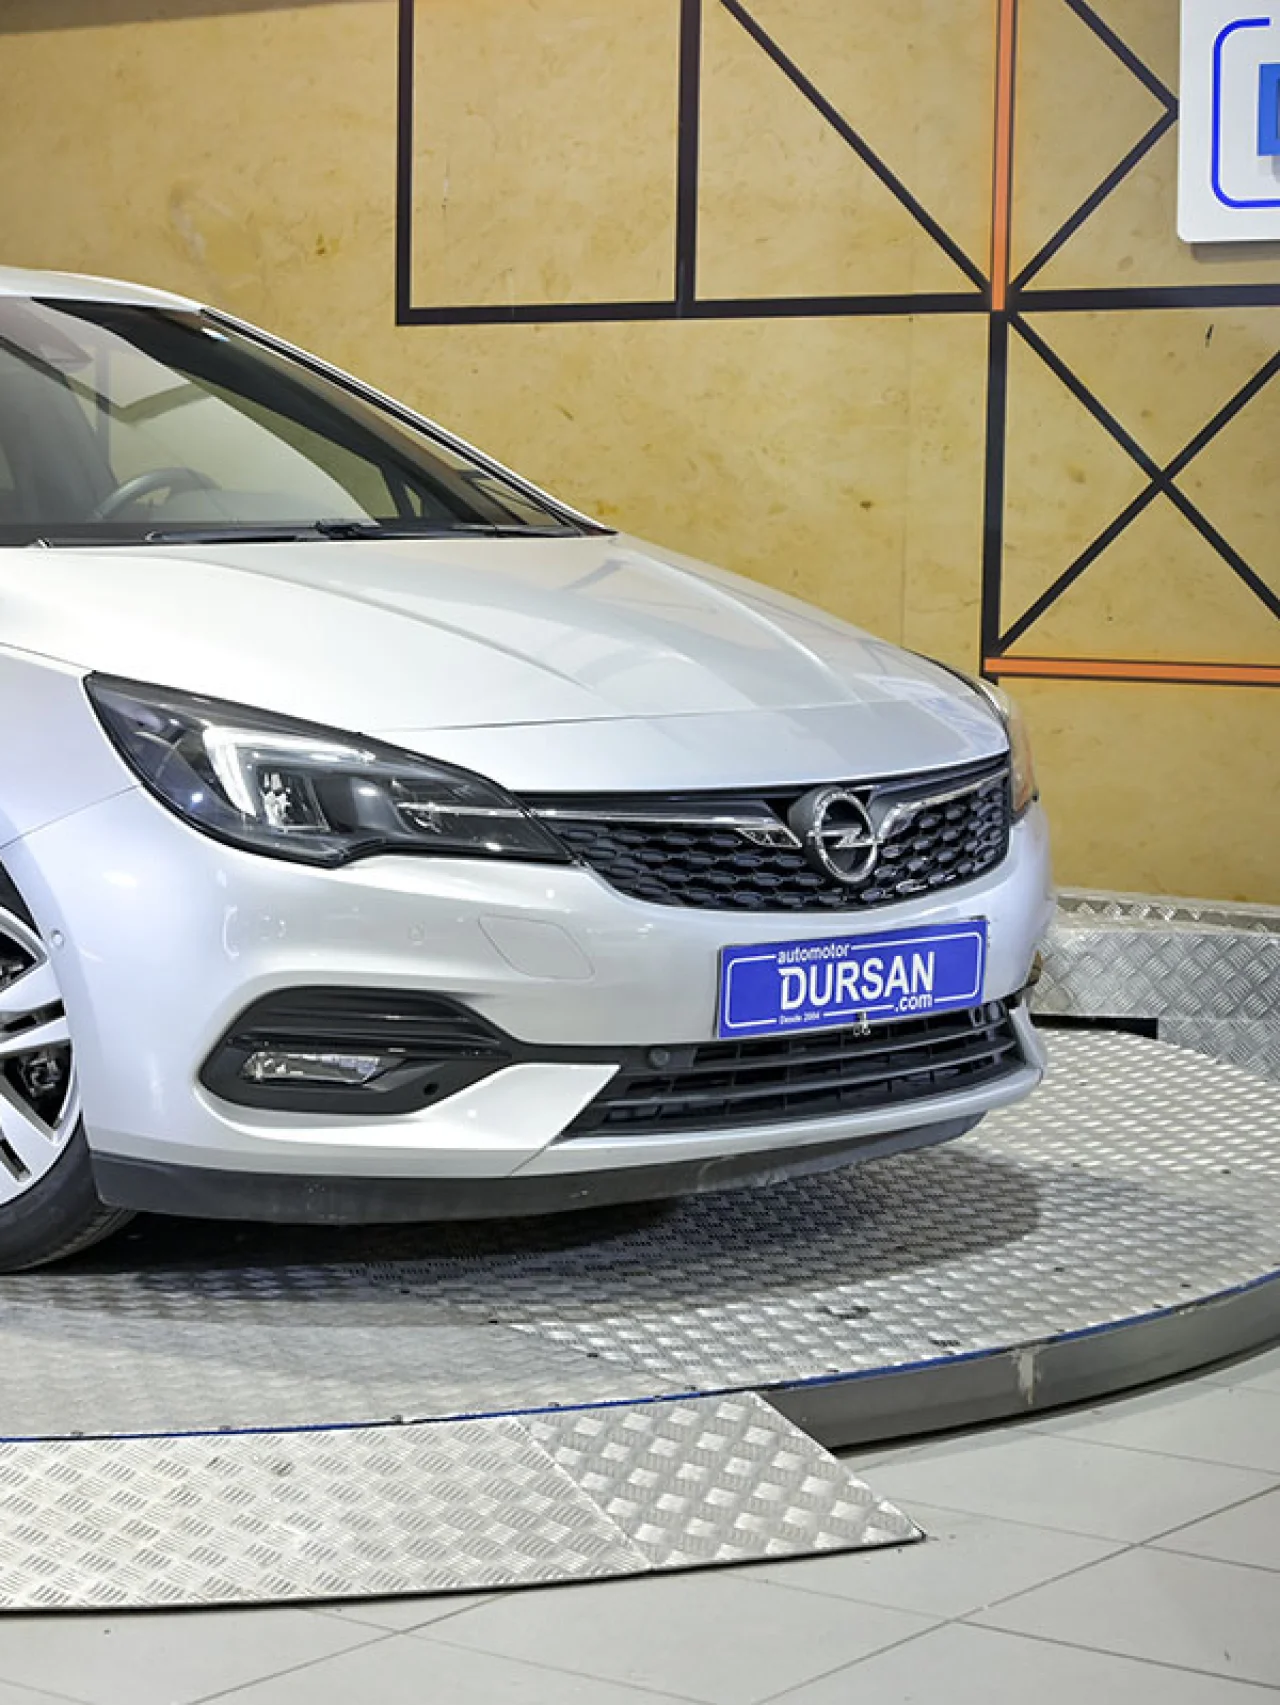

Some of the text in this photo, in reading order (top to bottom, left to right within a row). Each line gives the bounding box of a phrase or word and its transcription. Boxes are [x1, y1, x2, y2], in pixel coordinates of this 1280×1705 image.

[778, 943, 850, 964] automotor
[778, 951, 935, 1011] DURSAN
[894, 993, 933, 1012] .com
